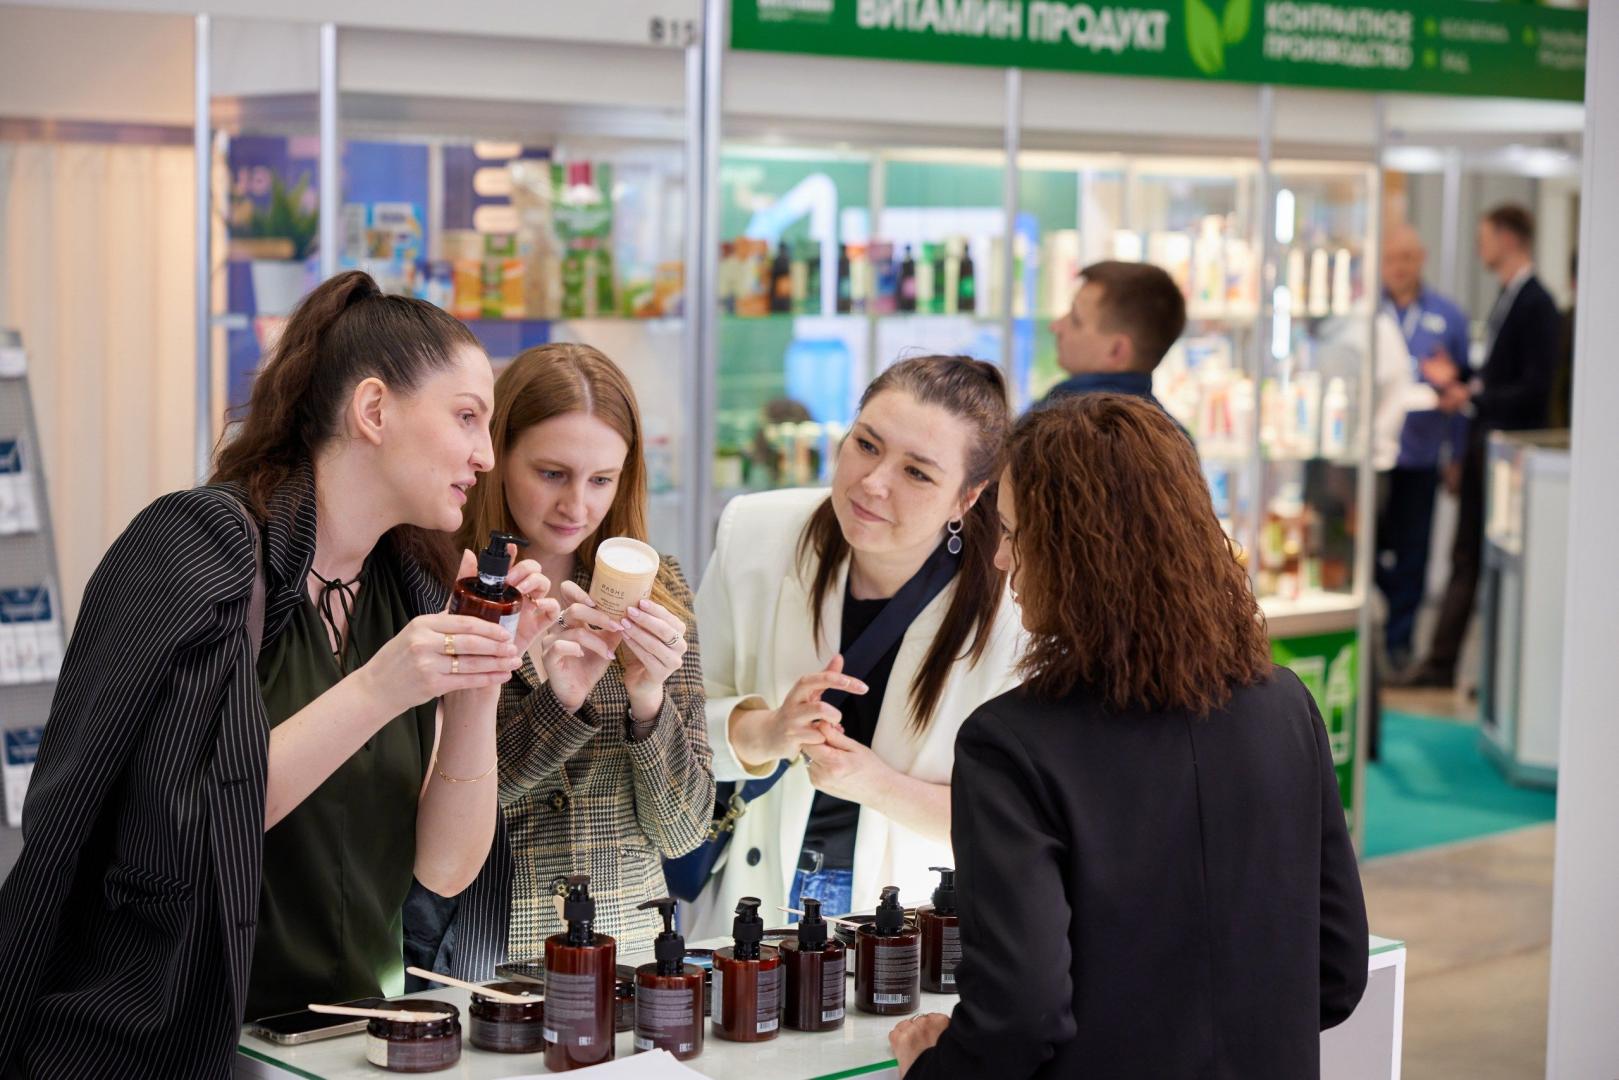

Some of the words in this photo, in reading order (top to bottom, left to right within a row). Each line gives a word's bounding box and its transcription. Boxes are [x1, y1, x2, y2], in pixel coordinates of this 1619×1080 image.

[856, 0, 1022, 39] ВИТАМИН
[1028, 2, 1169, 53] ПРОДУКТ
[1264, 1, 1412, 41] КОНТРАКТНОЕ
[1263, 32, 1413, 69] ПРОИЗВОДСТВО
